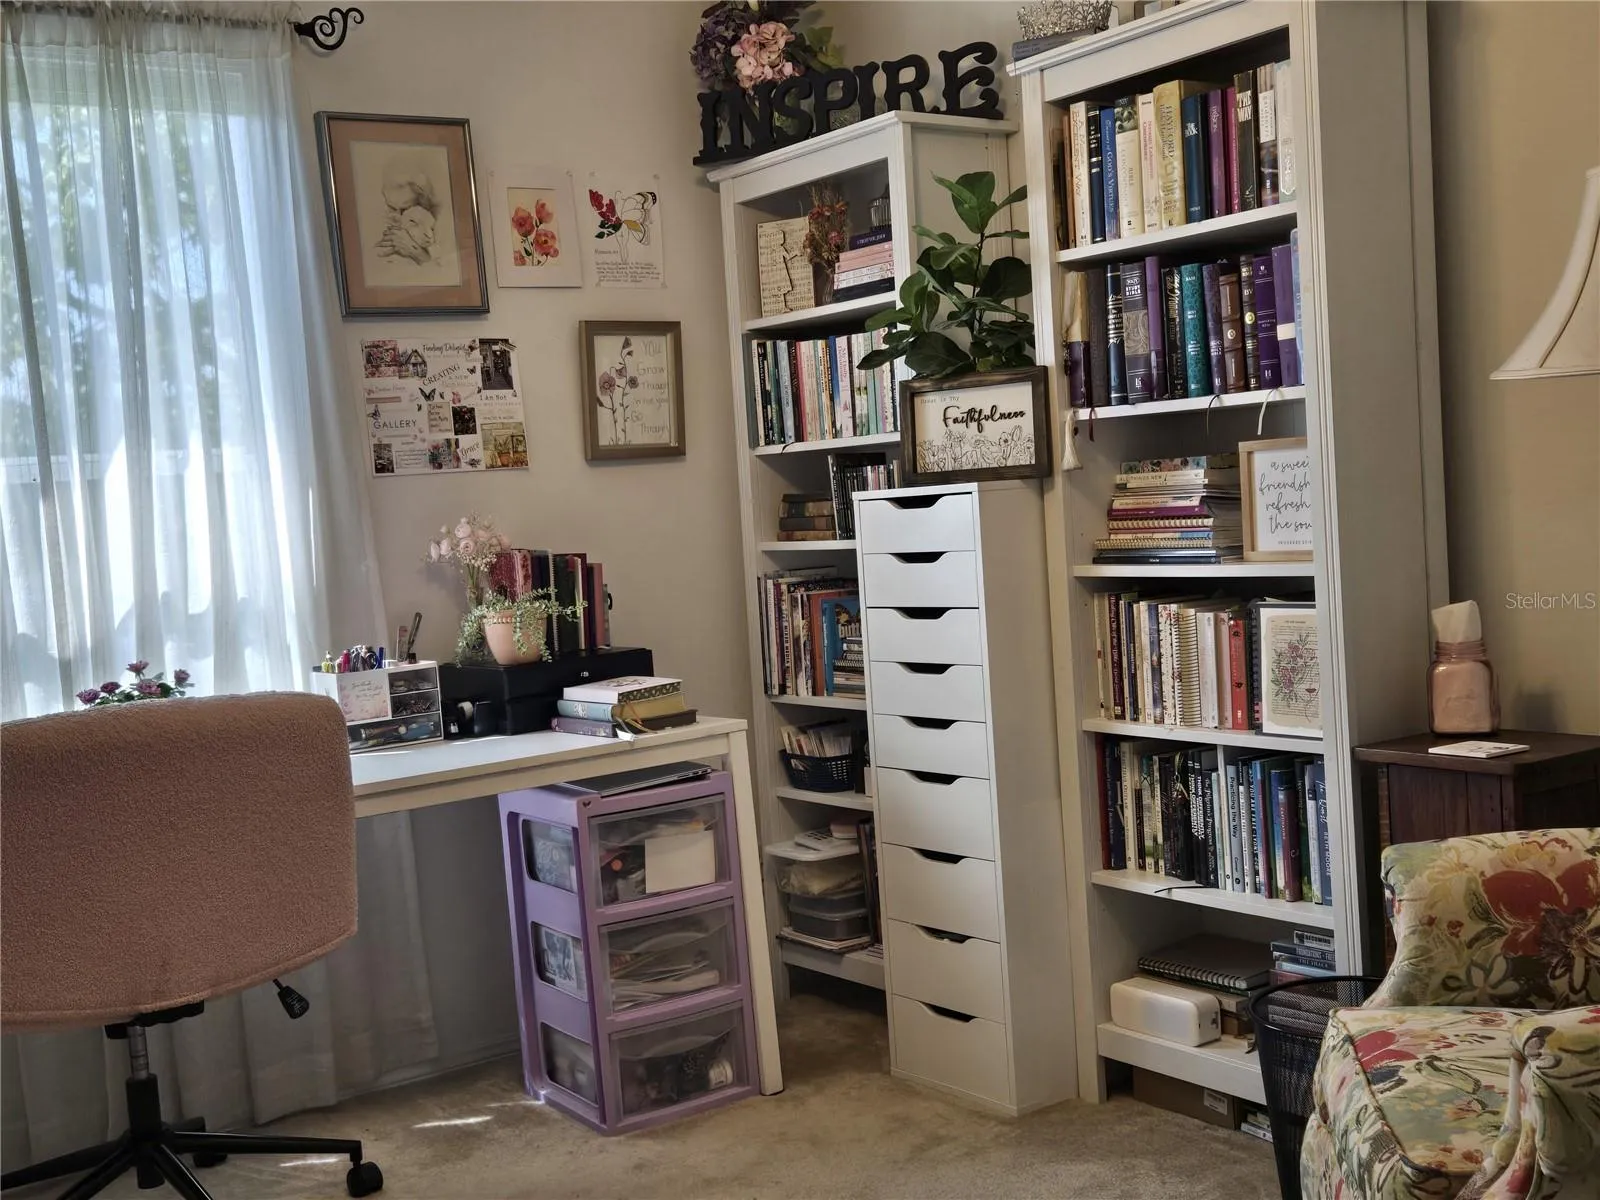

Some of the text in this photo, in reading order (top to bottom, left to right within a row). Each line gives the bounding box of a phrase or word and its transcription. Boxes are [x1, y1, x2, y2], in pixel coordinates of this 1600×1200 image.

[694, 41, 1003, 165] INSPIRE
[1237, 105, 1252, 122] WAY
[422, 363, 460, 386] CREATING
[373, 419, 417, 429] GALLERY
[942, 405, 1026, 433] Faithfulness
[1270, 456, 1310, 472] a swee
[1259, 471, 1310, 496] friendsh
[1269, 513, 1312, 534] the sou
[1315, 780, 1324, 792] The
[1318, 799, 1327, 824] Quest
